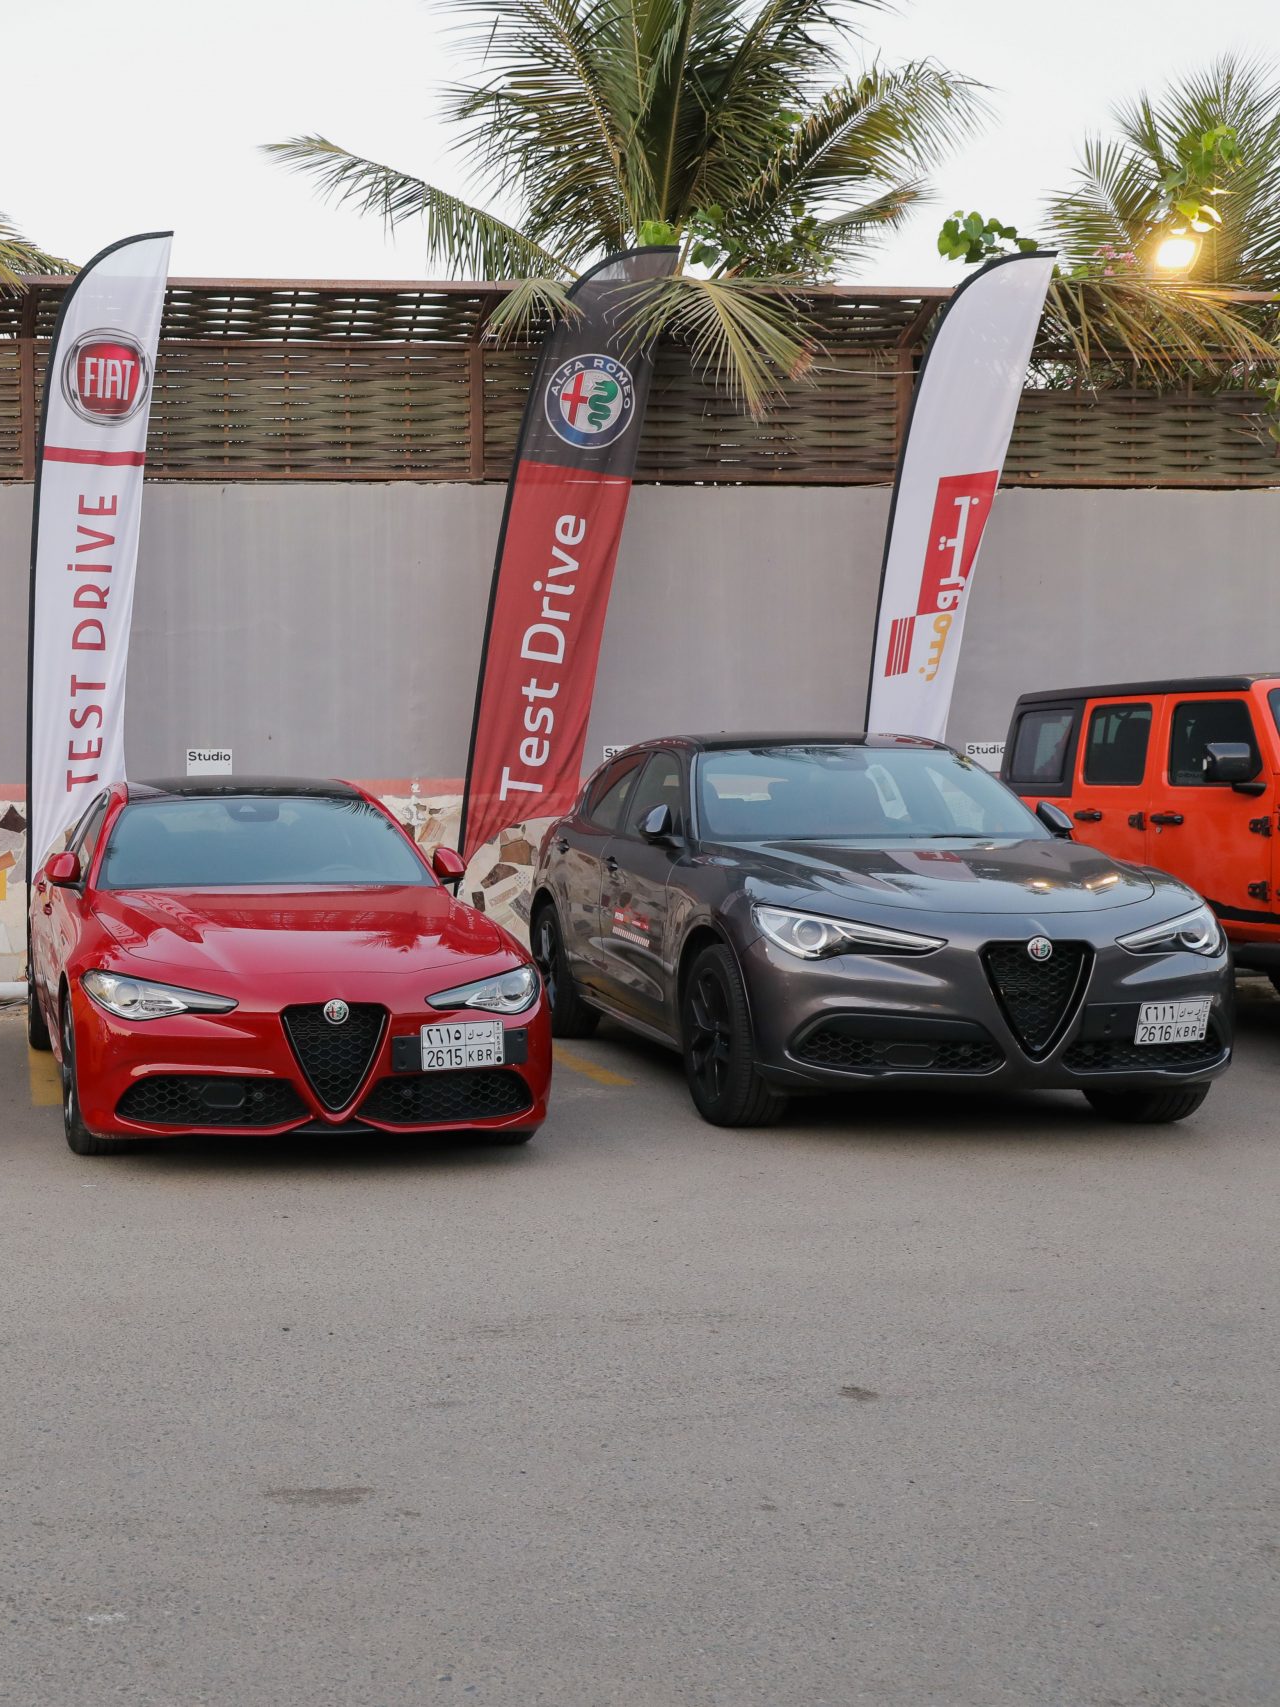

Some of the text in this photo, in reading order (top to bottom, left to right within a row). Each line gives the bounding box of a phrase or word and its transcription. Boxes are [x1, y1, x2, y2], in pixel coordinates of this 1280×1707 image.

[83, 357, 135, 400] FIAT
[551, 358, 631, 409] ALFA ROMEO
[499, 514, 586, 801] Test Drive
[66, 674, 106, 792] TEST
[188, 751, 231, 761] Studio
[1140, 1025, 1197, 1042] 2616 KBR
[427, 1048, 492, 1068] 2615 KBR
